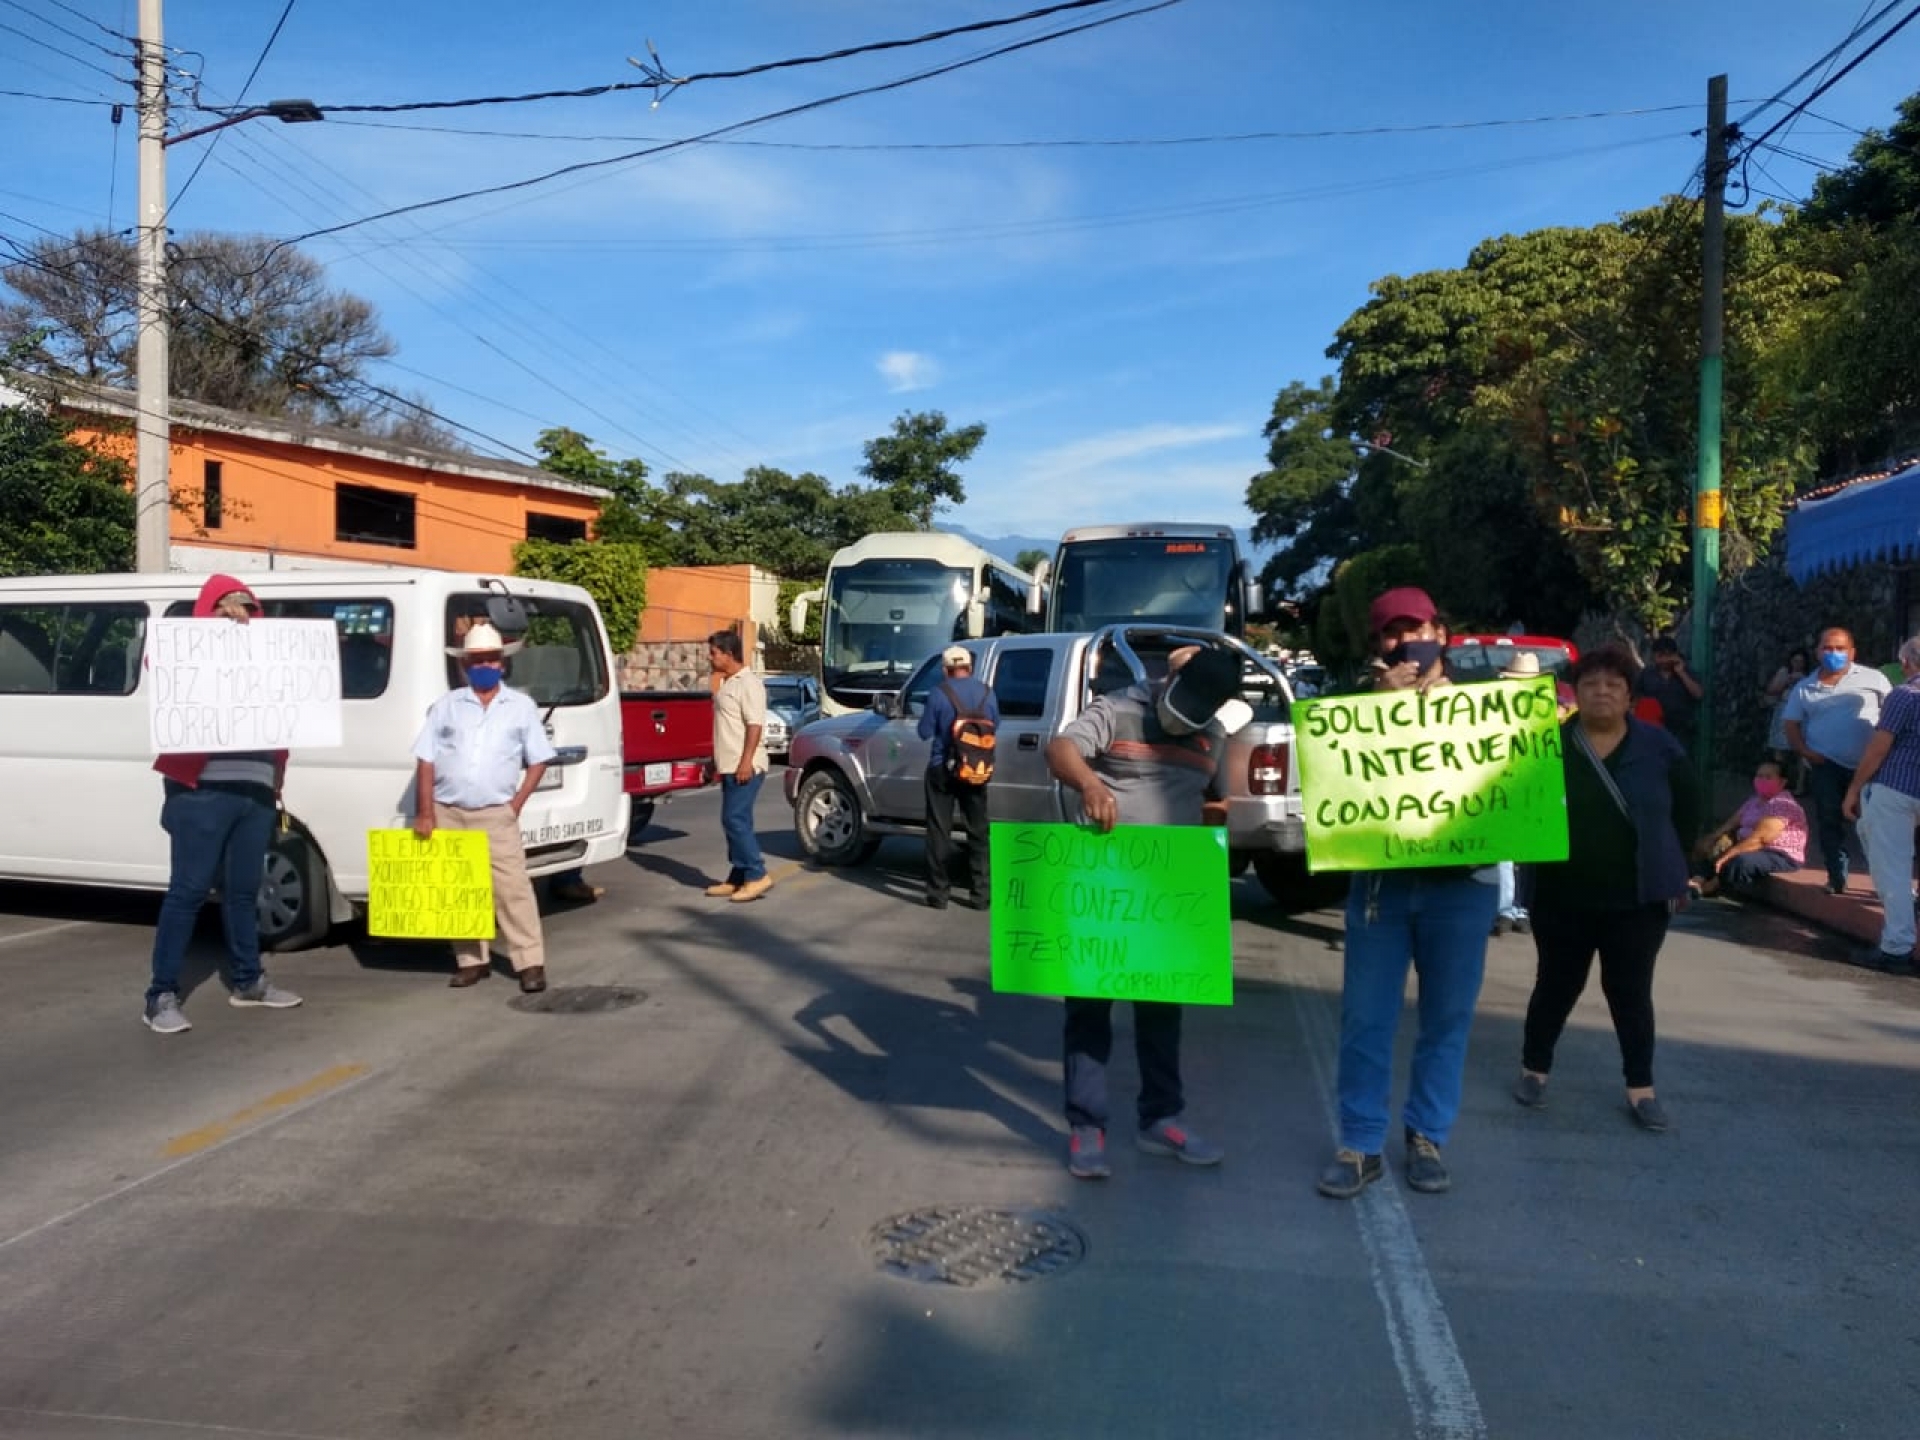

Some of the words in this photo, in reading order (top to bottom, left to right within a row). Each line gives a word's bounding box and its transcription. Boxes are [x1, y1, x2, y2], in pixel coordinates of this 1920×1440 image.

[156, 623, 252, 661] FERMIN
[156, 666, 200, 704] DEZ
[216, 665, 334, 703] MORGADO
[1305, 684, 1555, 737] SOLICITAMOS
[371, 830, 390, 857] EL
[563, 821, 585, 837] SANTA
[1010, 830, 1171, 869] SOLUCION
[1005, 877, 1030, 910] AL
[1048, 880, 1210, 927] CONFLICTO
[1005, 930, 1128, 970] FERMIN
